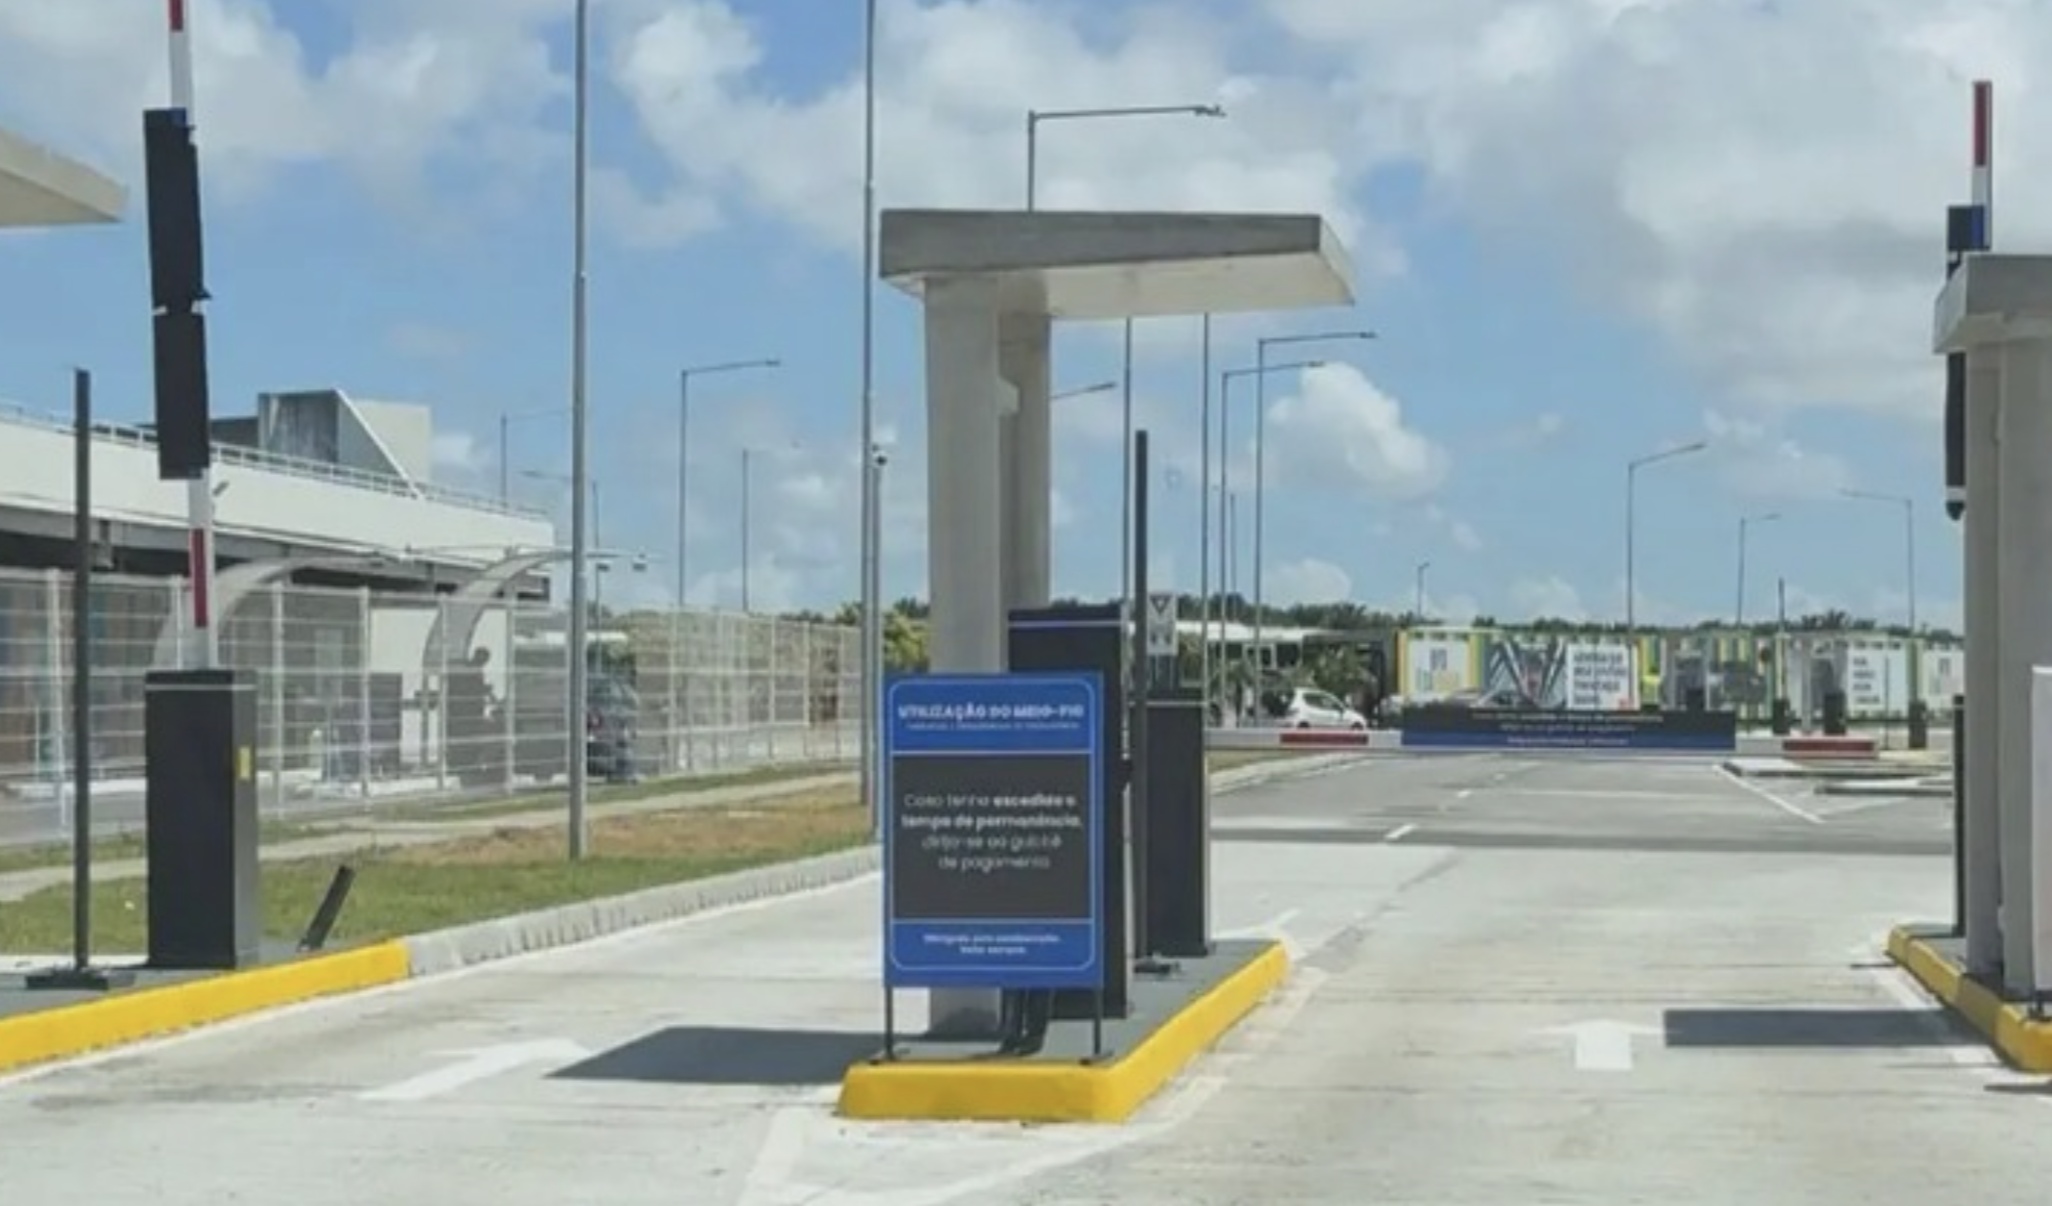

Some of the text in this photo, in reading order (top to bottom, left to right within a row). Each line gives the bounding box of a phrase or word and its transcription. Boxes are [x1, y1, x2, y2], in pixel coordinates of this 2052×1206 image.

[898, 702, 1084, 720] UTILIZAÇÃO DO MEIO-FIO
[904, 794, 943, 807] Caso
[947, 793, 989, 807] tenha
[1065, 796, 1076, 807] o
[901, 814, 951, 831] tempo
[955, 813, 973, 827] de
[988, 838, 1006, 848] ao
[939, 857, 957, 869] de
